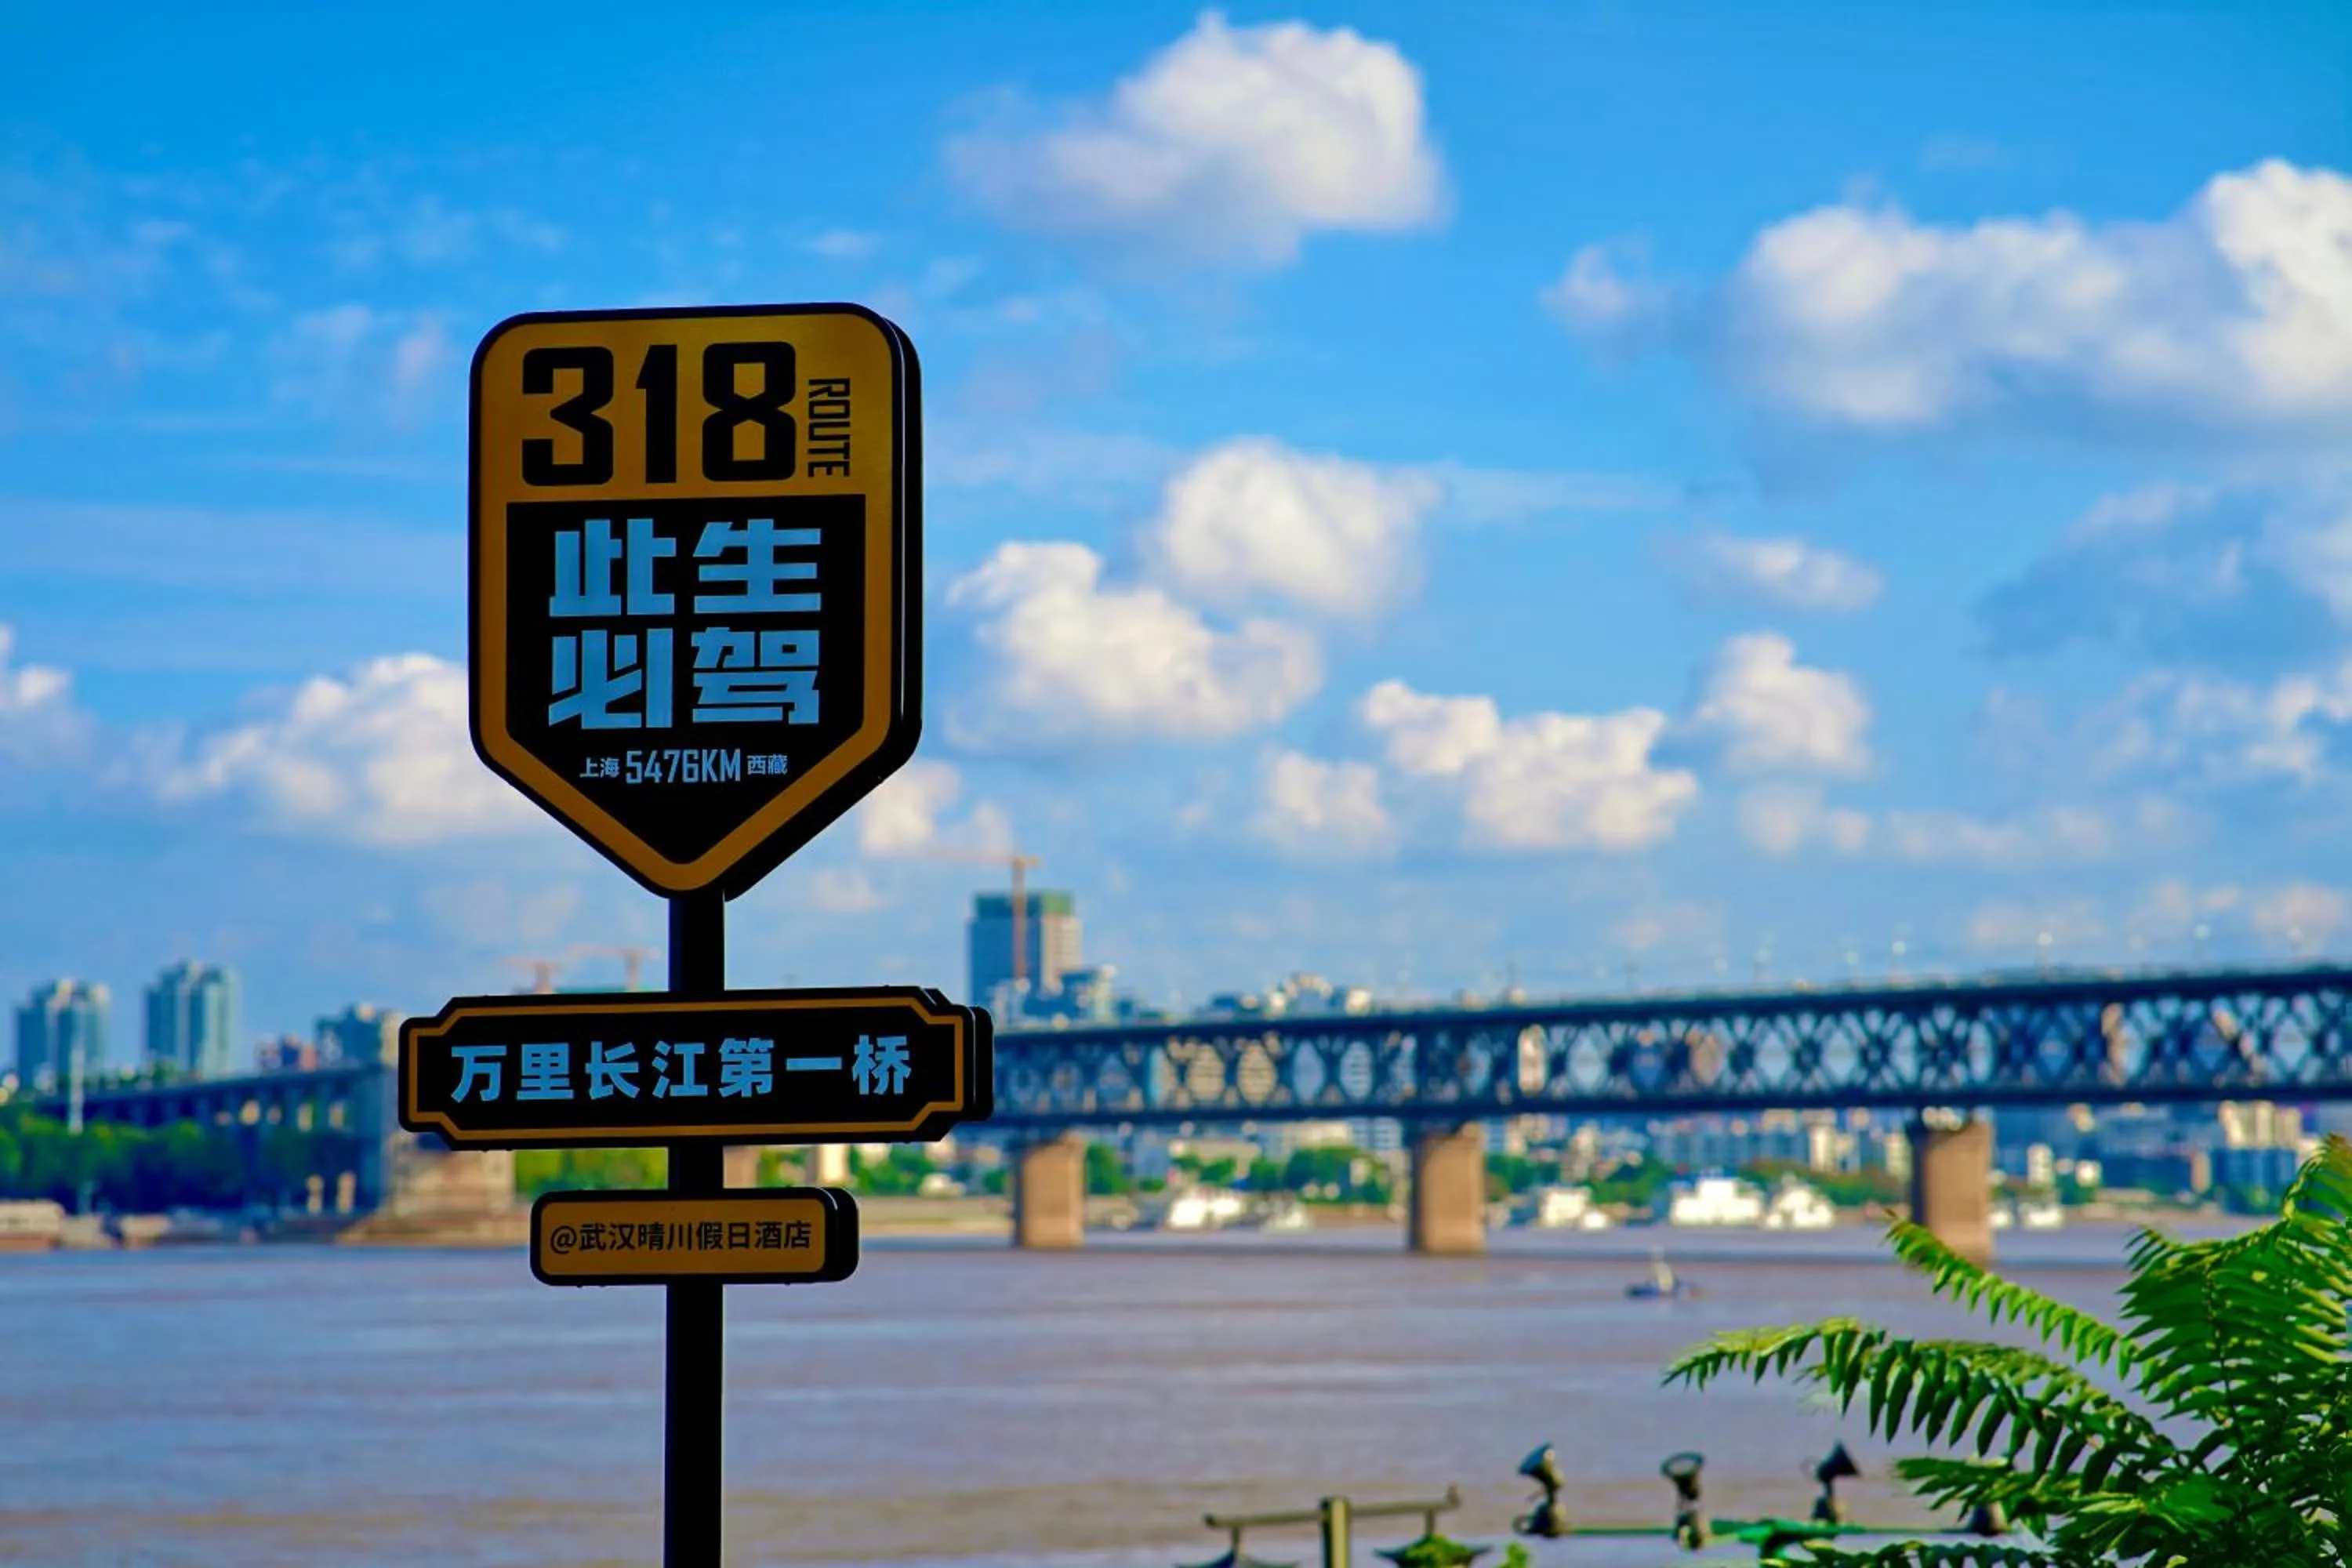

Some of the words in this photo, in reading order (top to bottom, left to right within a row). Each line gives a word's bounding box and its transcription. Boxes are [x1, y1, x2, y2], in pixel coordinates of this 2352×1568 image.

[521, 341, 797, 487] 318
[807, 377, 851, 477] ROUTE
[549, 518, 822, 617] 此生
[548, 626, 820, 730] 必驾
[579, 757, 620, 779] 上海
[626, 748, 742, 784] 5476KM
[746, 753, 788, 776] 西藏
[451, 1034, 913, 1103] 万里长江第一桥
[549, 1219, 812, 1254] @武汉晴川假日酒店
